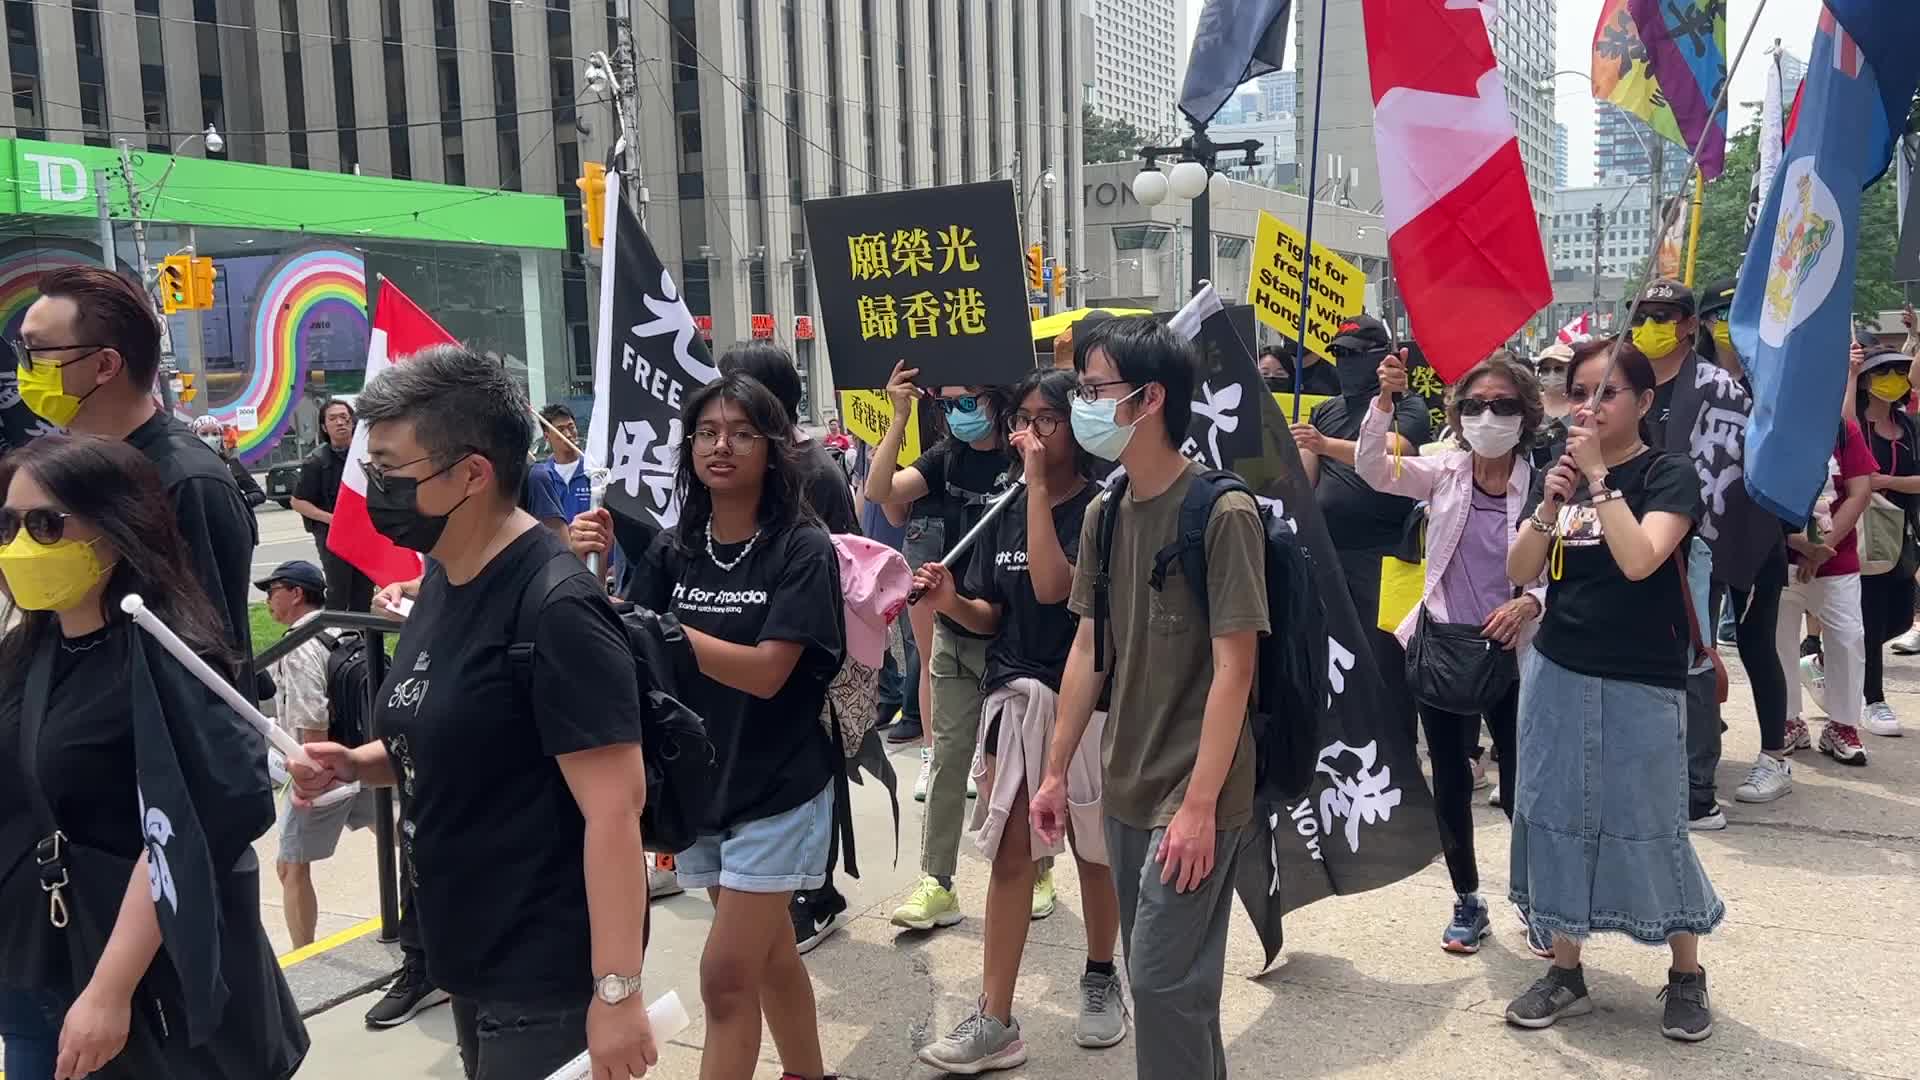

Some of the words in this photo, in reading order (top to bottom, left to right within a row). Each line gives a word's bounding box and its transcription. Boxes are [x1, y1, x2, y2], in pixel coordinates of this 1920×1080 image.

[24, 153, 88, 201] TD
[848, 225, 981, 280] 願榮光
[1324, 260, 1348, 287] for
[857, 287, 988, 340] 歸香港
[1256, 287, 1301, 332] Hong
[1316, 303, 1346, 329] wit
[621, 342, 683, 411] FREE
